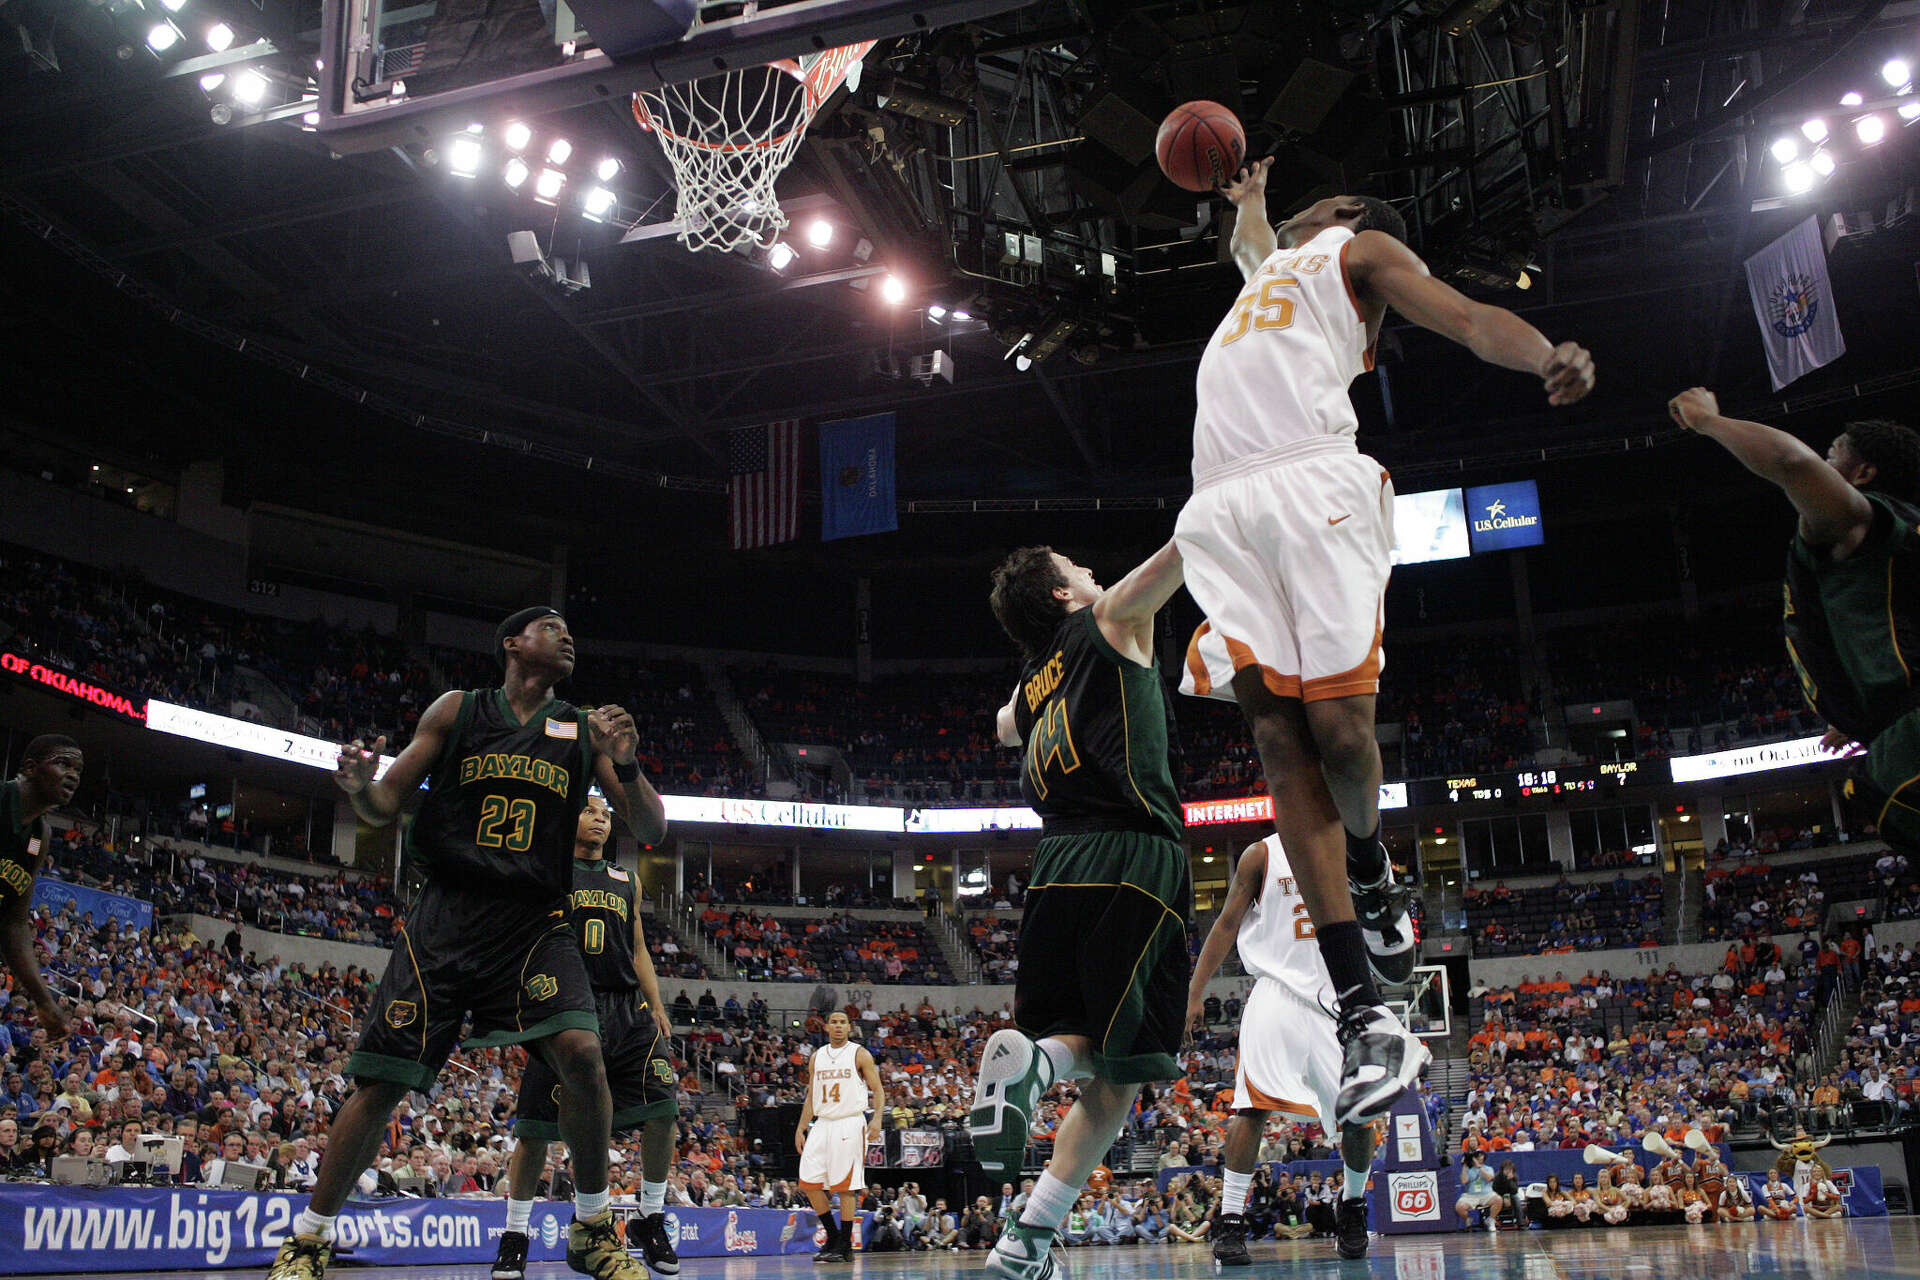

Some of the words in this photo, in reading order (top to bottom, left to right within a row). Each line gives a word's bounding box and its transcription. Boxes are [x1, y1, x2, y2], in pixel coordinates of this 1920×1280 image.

[1220, 278, 1300, 347] 35
[1493, 515, 1538, 530] Cellular
[0, 653, 31, 674] OF
[1025, 651, 1065, 714] BRUCE
[1028, 697, 1081, 801] 14
[459, 754, 569, 800] BAYLOR
[1447, 778, 1477, 789] TEXAS
[1450, 789, 1459, 802] 4
[1617, 773, 1627, 786] 7
[760, 803, 848, 827] Cellular
[1187, 801, 1265, 822] INTERNET
[476, 795, 536, 852] 23
[41, 886, 70, 902] Ford
[105, 900, 131, 918] Ford
[585, 918, 605, 955] 0
[816, 1069, 852, 1081] TEXAS
[821, 1083, 841, 1104] 14
[903, 1132, 938, 1145] Studio
[1398, 1181, 1429, 1189] PHILLIPS
[1400, 1192, 1428, 1209] 66
